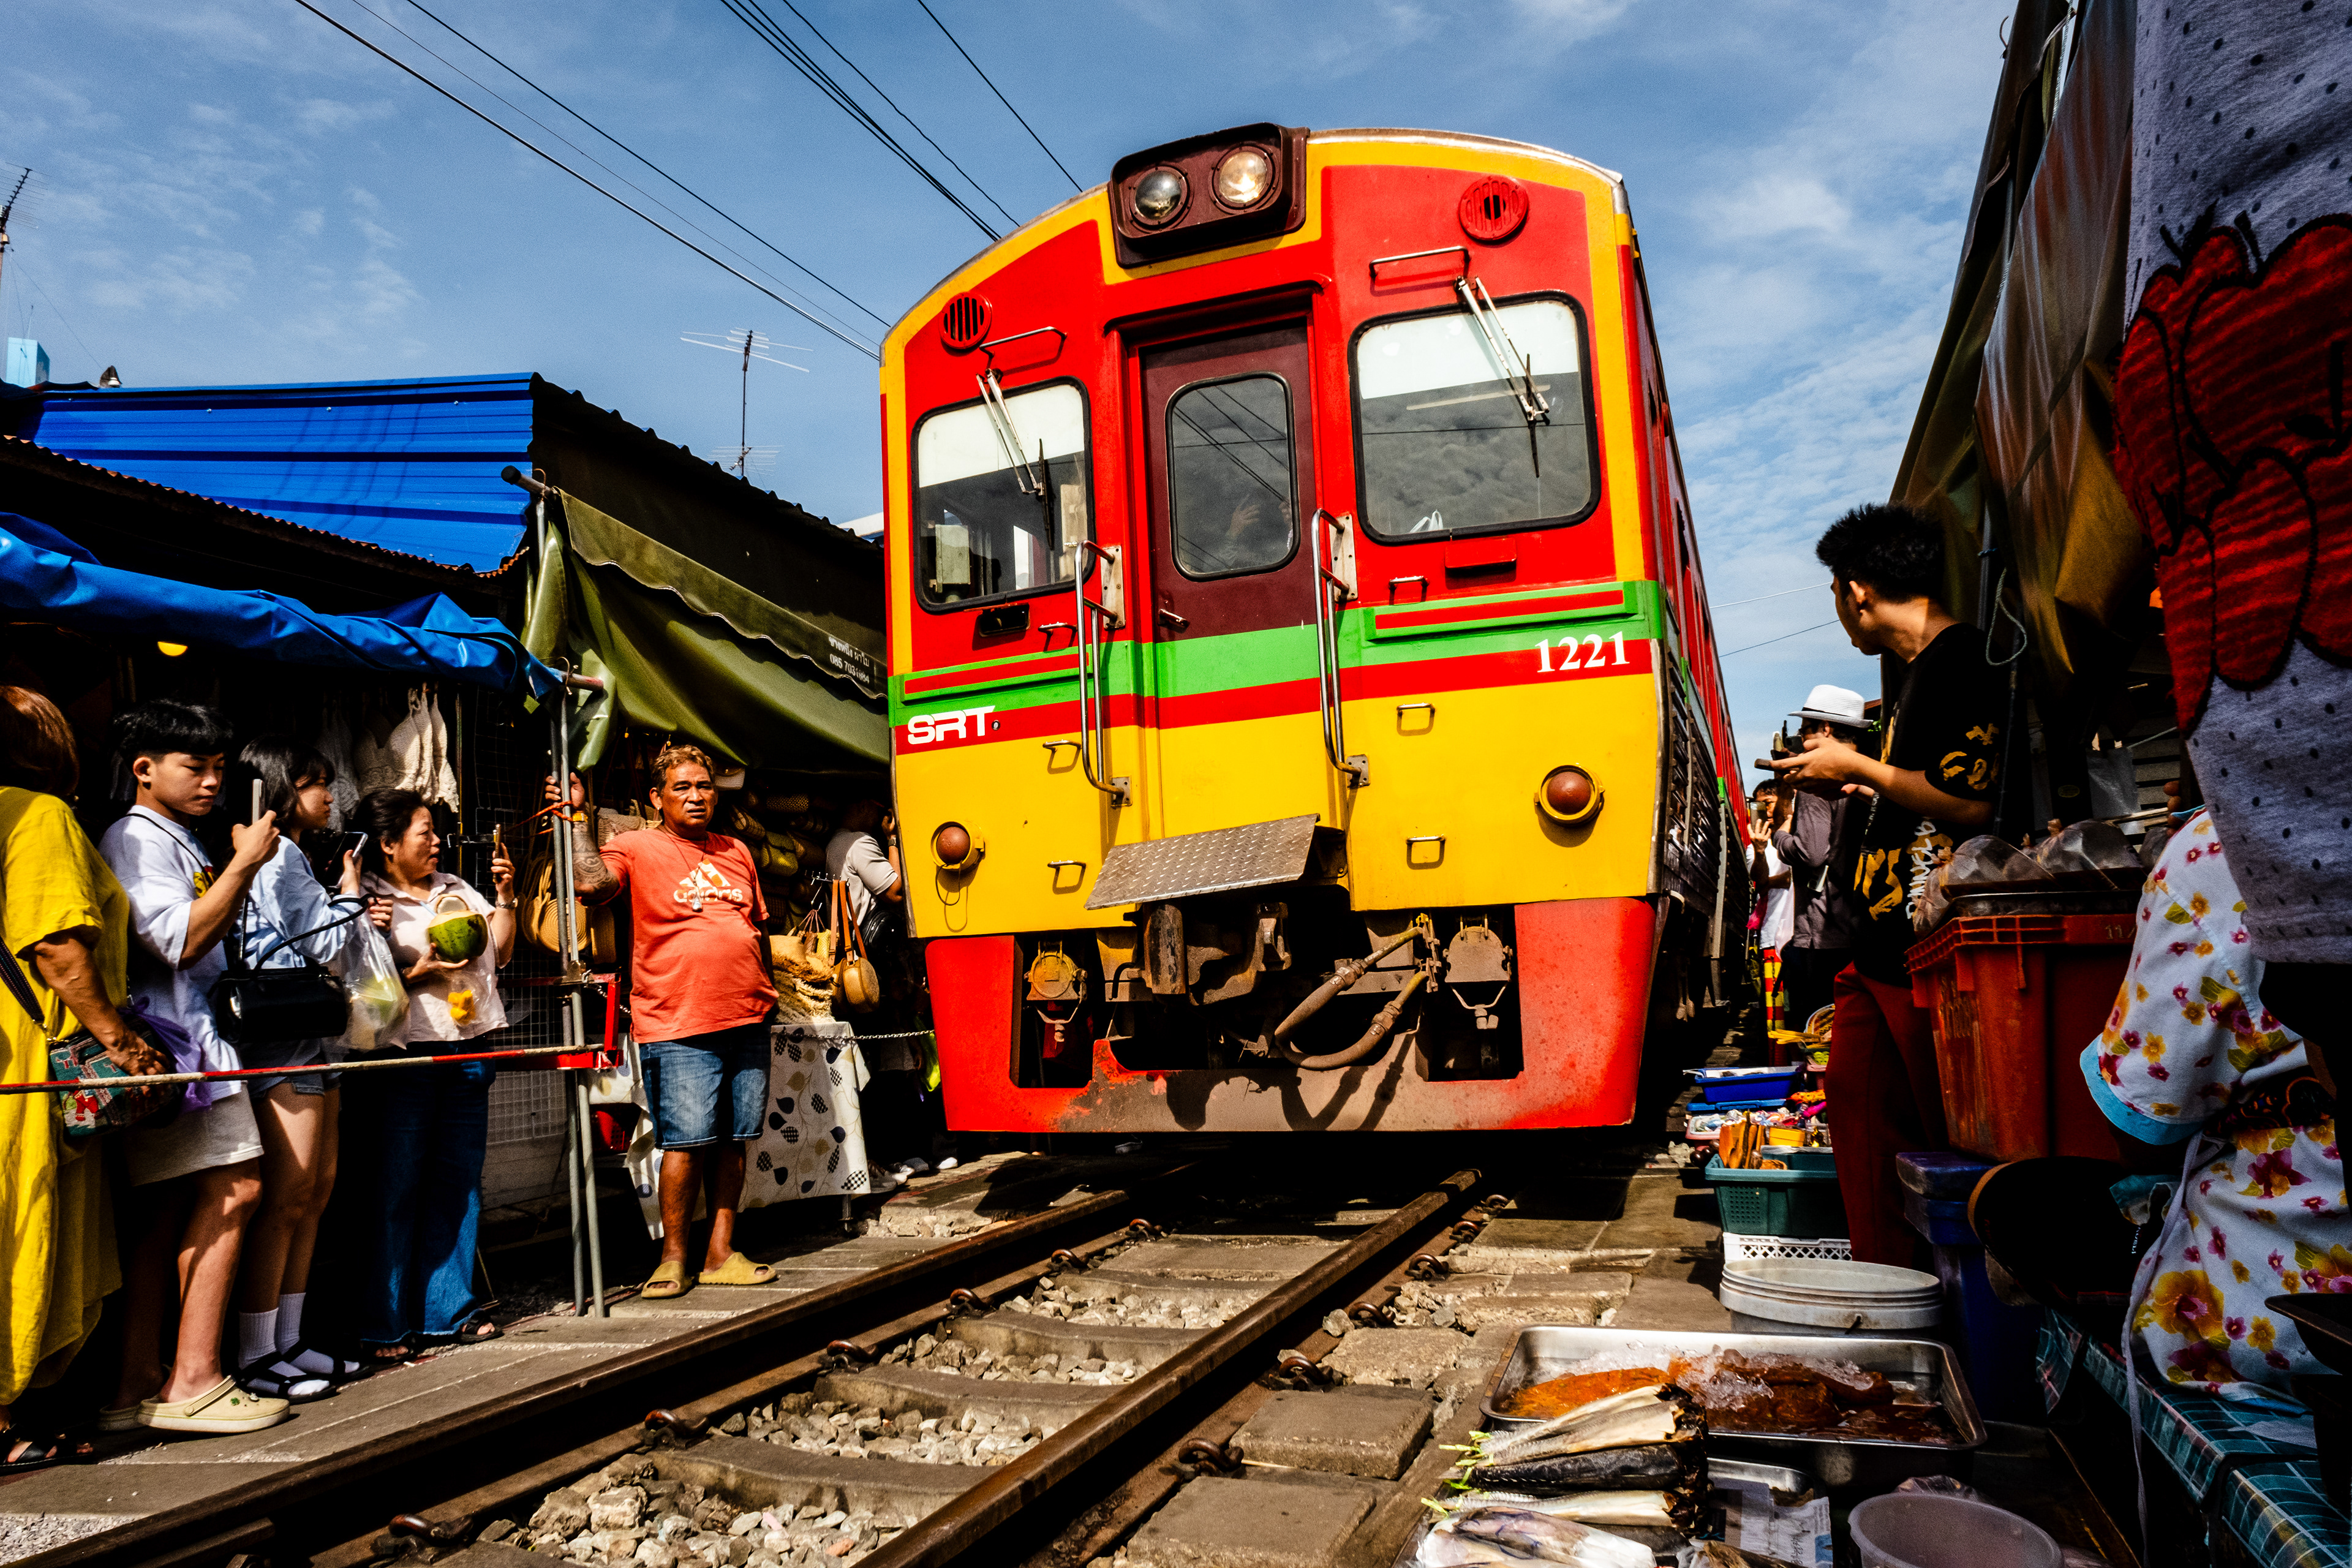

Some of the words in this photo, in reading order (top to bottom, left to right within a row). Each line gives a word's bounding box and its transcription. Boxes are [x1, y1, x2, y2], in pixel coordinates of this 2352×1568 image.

[829, 653, 843, 669] 085
[1535, 631, 1630, 673] 1221
[907, 705, 995, 745] SRT
[673, 886, 743, 903] adidas
